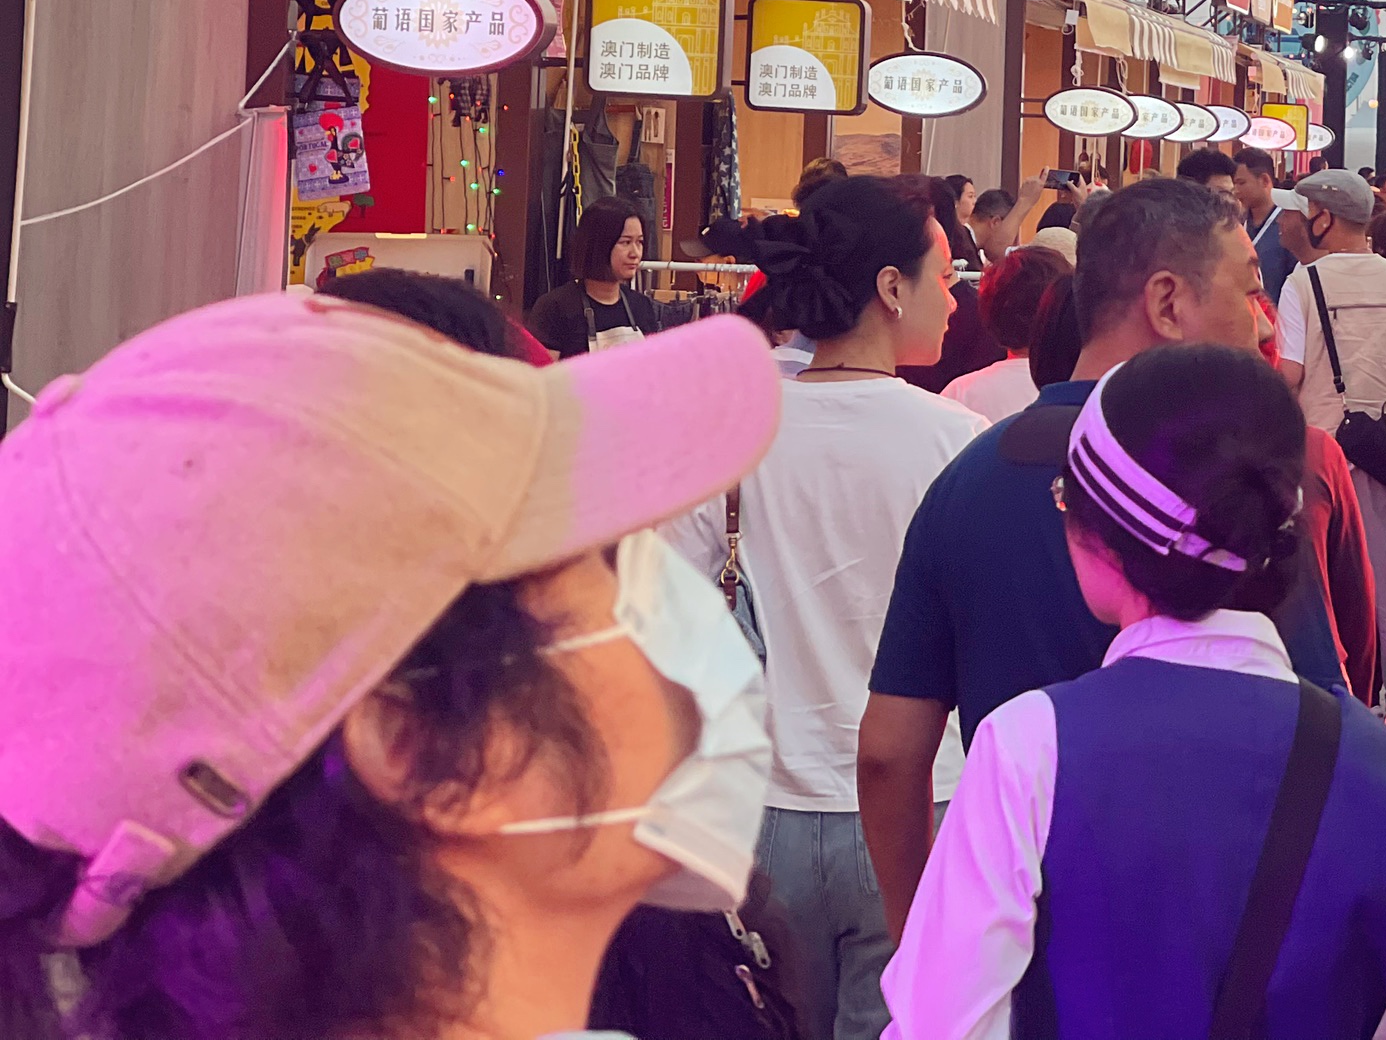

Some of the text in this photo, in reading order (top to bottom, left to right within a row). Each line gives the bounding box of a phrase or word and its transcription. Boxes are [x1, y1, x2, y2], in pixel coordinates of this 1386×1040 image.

[372, 6, 505, 36] 葡语国家产品
[600, 40, 671, 60] 澳门制造
[599, 62, 669, 82] 澳门品牌
[759, 63, 818, 81] 澳门制造
[758, 82, 817, 100] 澳门品牌
[883, 75, 963, 95] 葡语国家产品
[1060, 104, 1120, 120] 葡语国家产品
